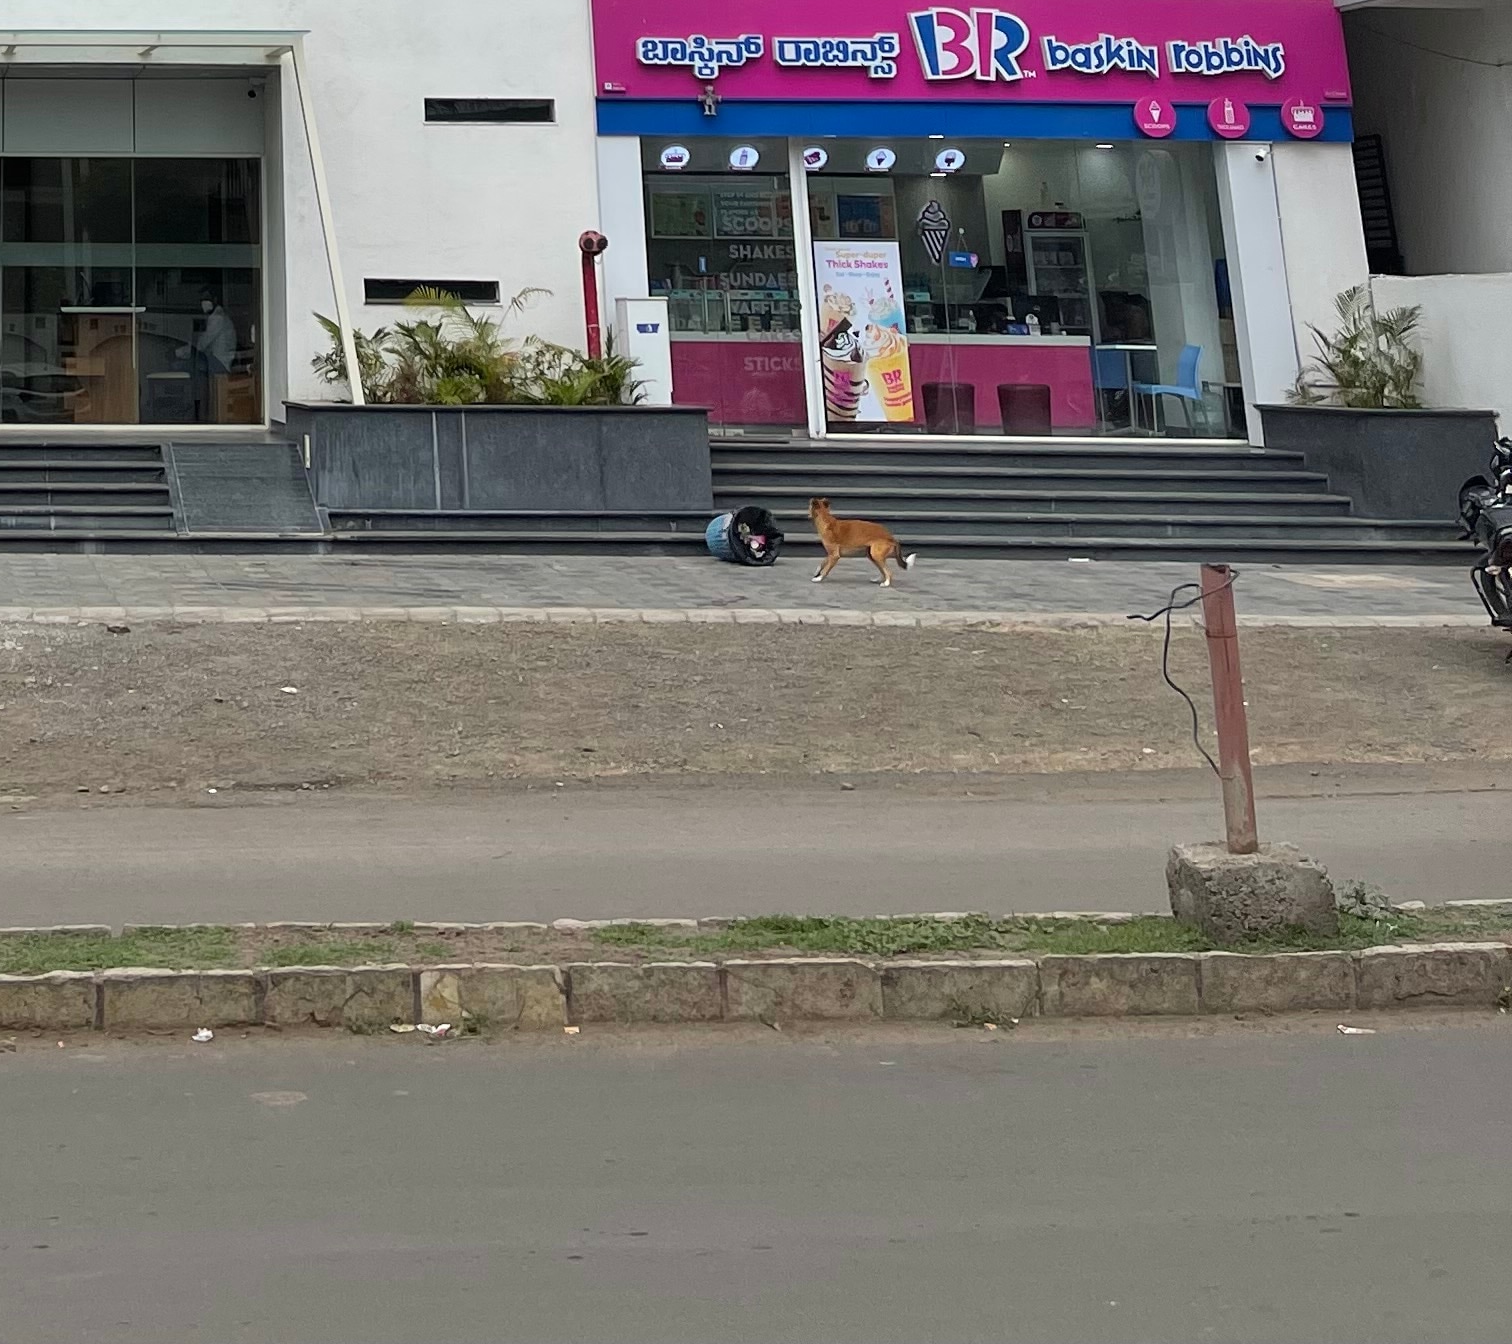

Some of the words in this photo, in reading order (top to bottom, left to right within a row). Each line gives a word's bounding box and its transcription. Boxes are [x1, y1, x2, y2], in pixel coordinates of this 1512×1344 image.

[911, 8, 1028, 80] BR
[1044, 34, 1158, 78] baskin
[1171, 35, 1284, 79] robbins
[826, 260, 852, 269] Thick
[854, 260, 888, 269] Shakes
